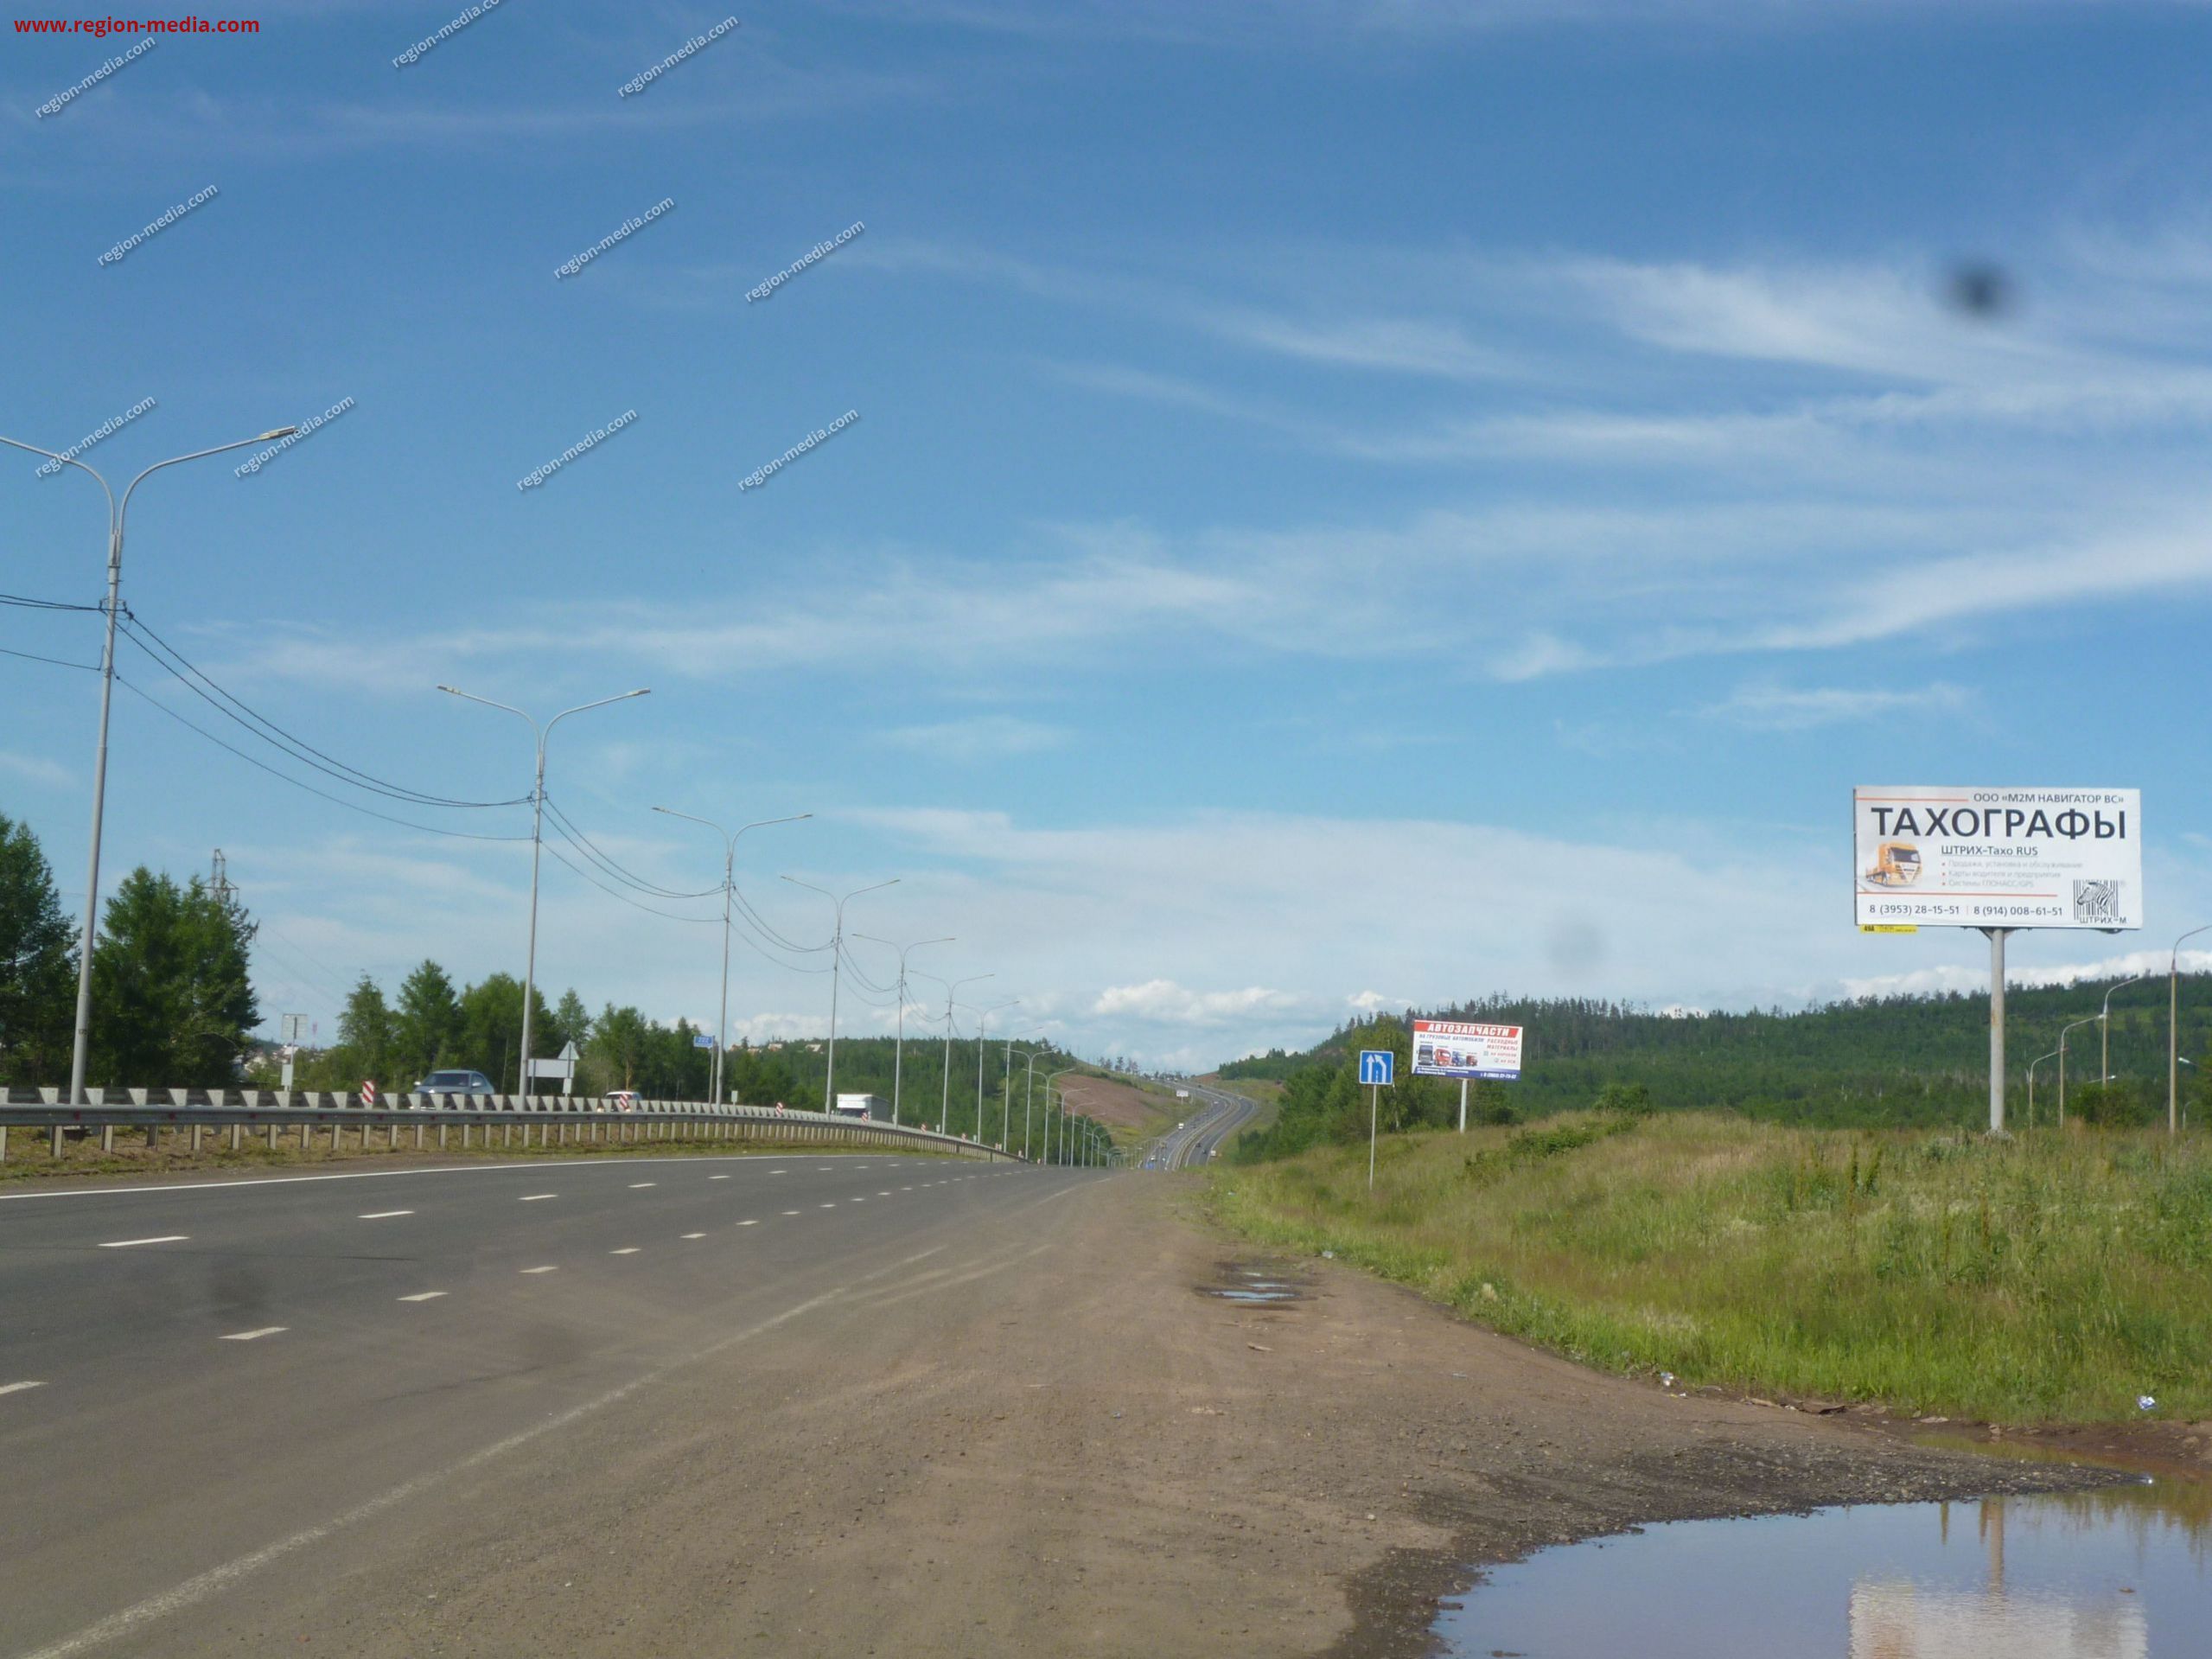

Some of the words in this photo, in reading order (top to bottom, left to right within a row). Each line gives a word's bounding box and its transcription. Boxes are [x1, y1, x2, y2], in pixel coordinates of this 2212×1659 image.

[1973, 794, 2000, 802] ООО
[2037, 794, 2101, 803] НАВИГАТОР
[1871, 807, 2126, 839] ТАХОГРАФЫ
[1941, 845, 2013, 856] ШТРИХ-Тахо
[2017, 846, 2038, 856] RUS
[1879, 904, 1912, 915] (3953)
[1915, 905, 1960, 915] 28-15-51
[1973, 906, 1980, 915] 8
[1983, 906, 2008, 916] (914)
[2011, 907, 2062, 916] 008-61-51
[2079, 916, 2127, 924] ШТРИХ-М
[1427, 1023, 1510, 1037] АВТОЗАПЧАСТИ
